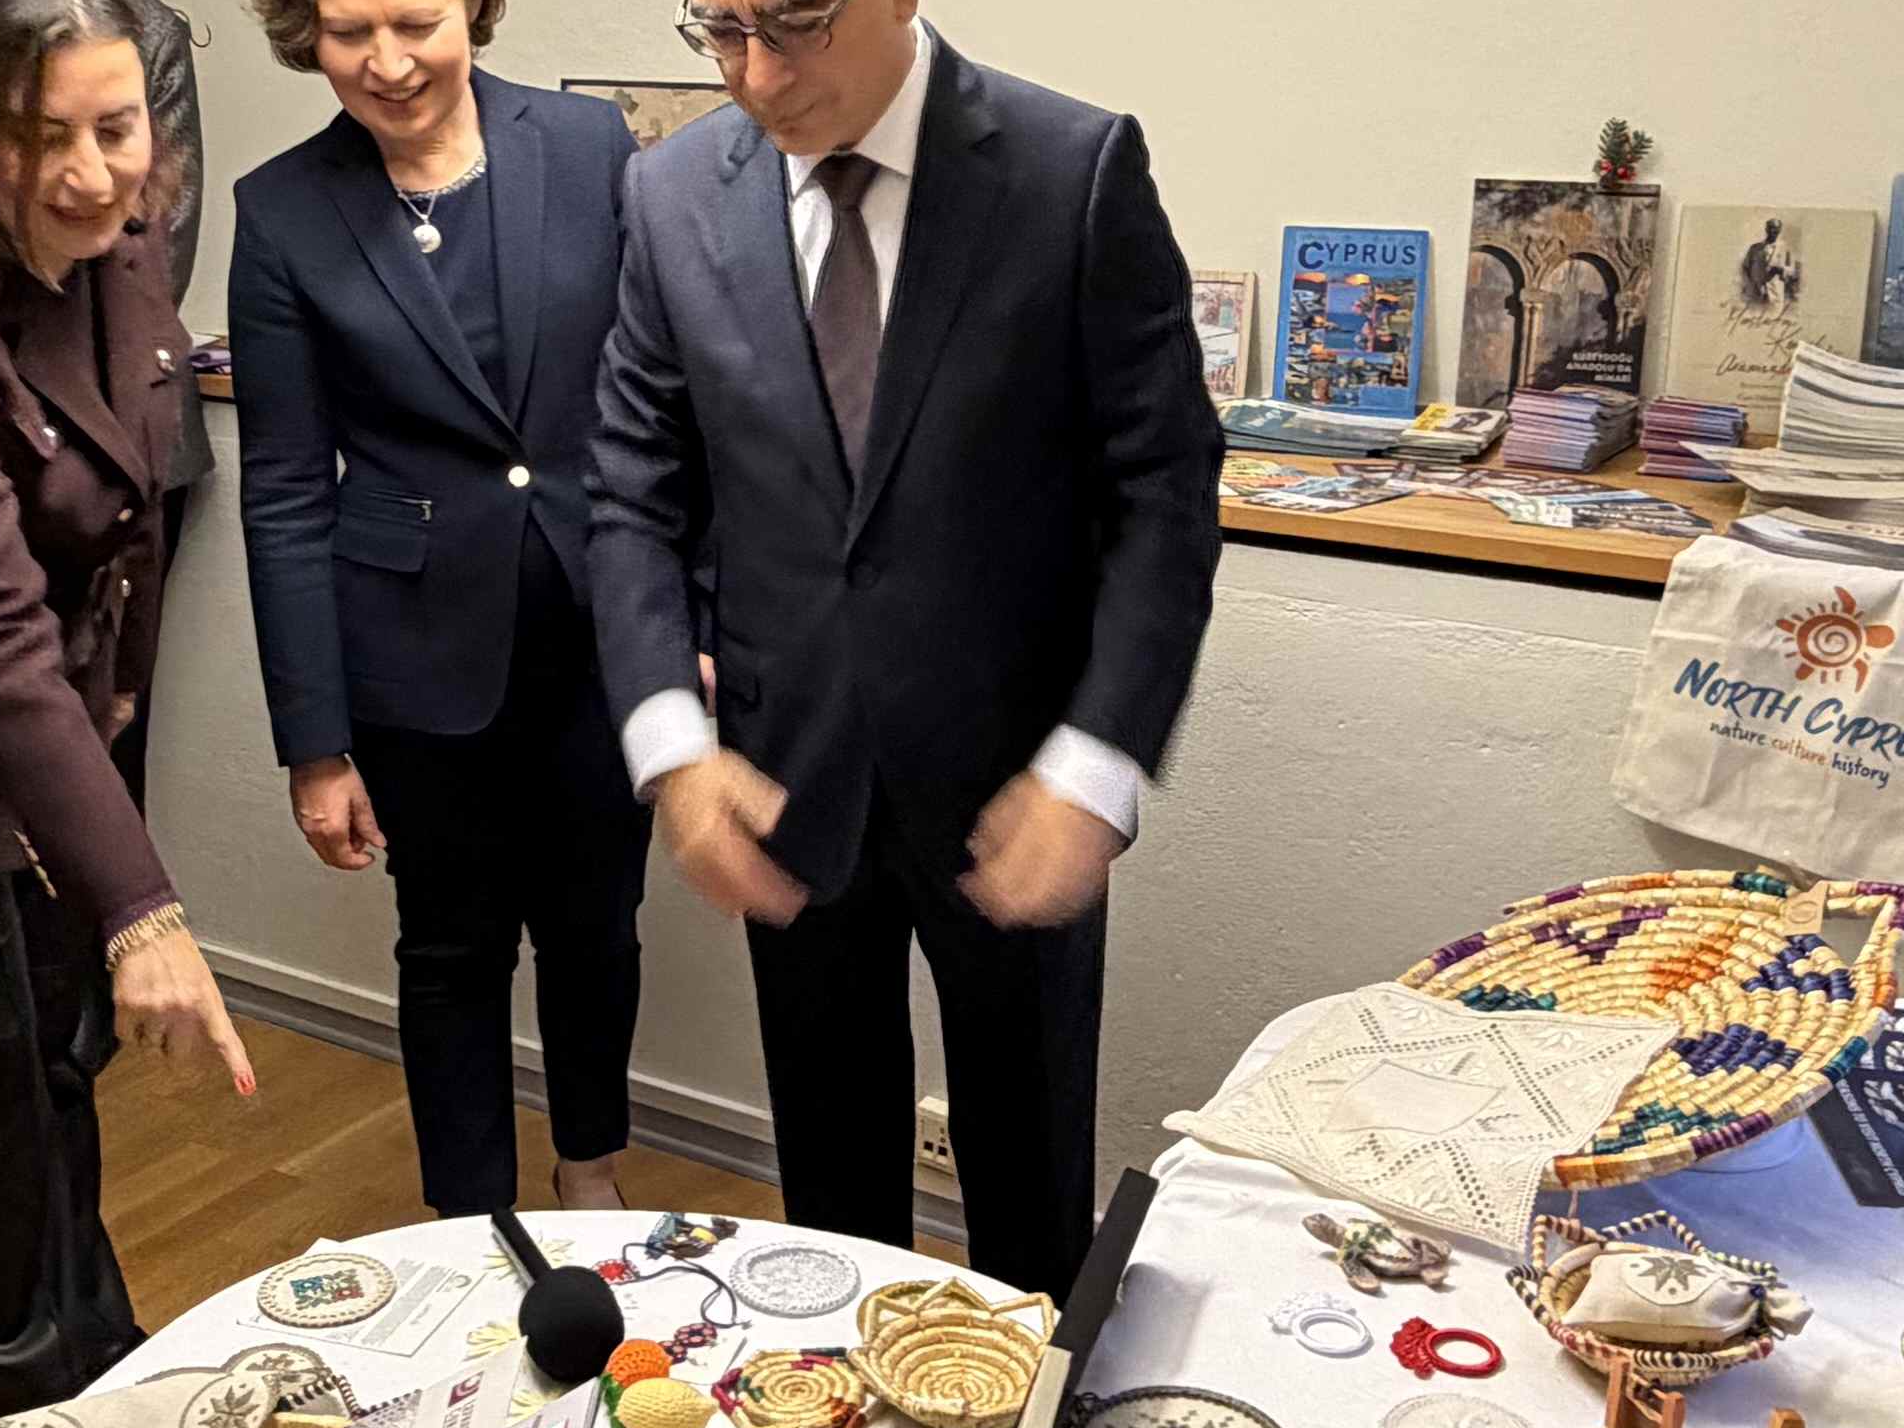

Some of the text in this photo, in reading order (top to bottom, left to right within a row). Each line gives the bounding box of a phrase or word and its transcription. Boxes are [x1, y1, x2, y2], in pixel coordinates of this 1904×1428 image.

[1298, 242, 1417, 269] CYPRUS
[1674, 658, 1802, 723] NORTH
[1709, 720, 1890, 789] nature culture history
